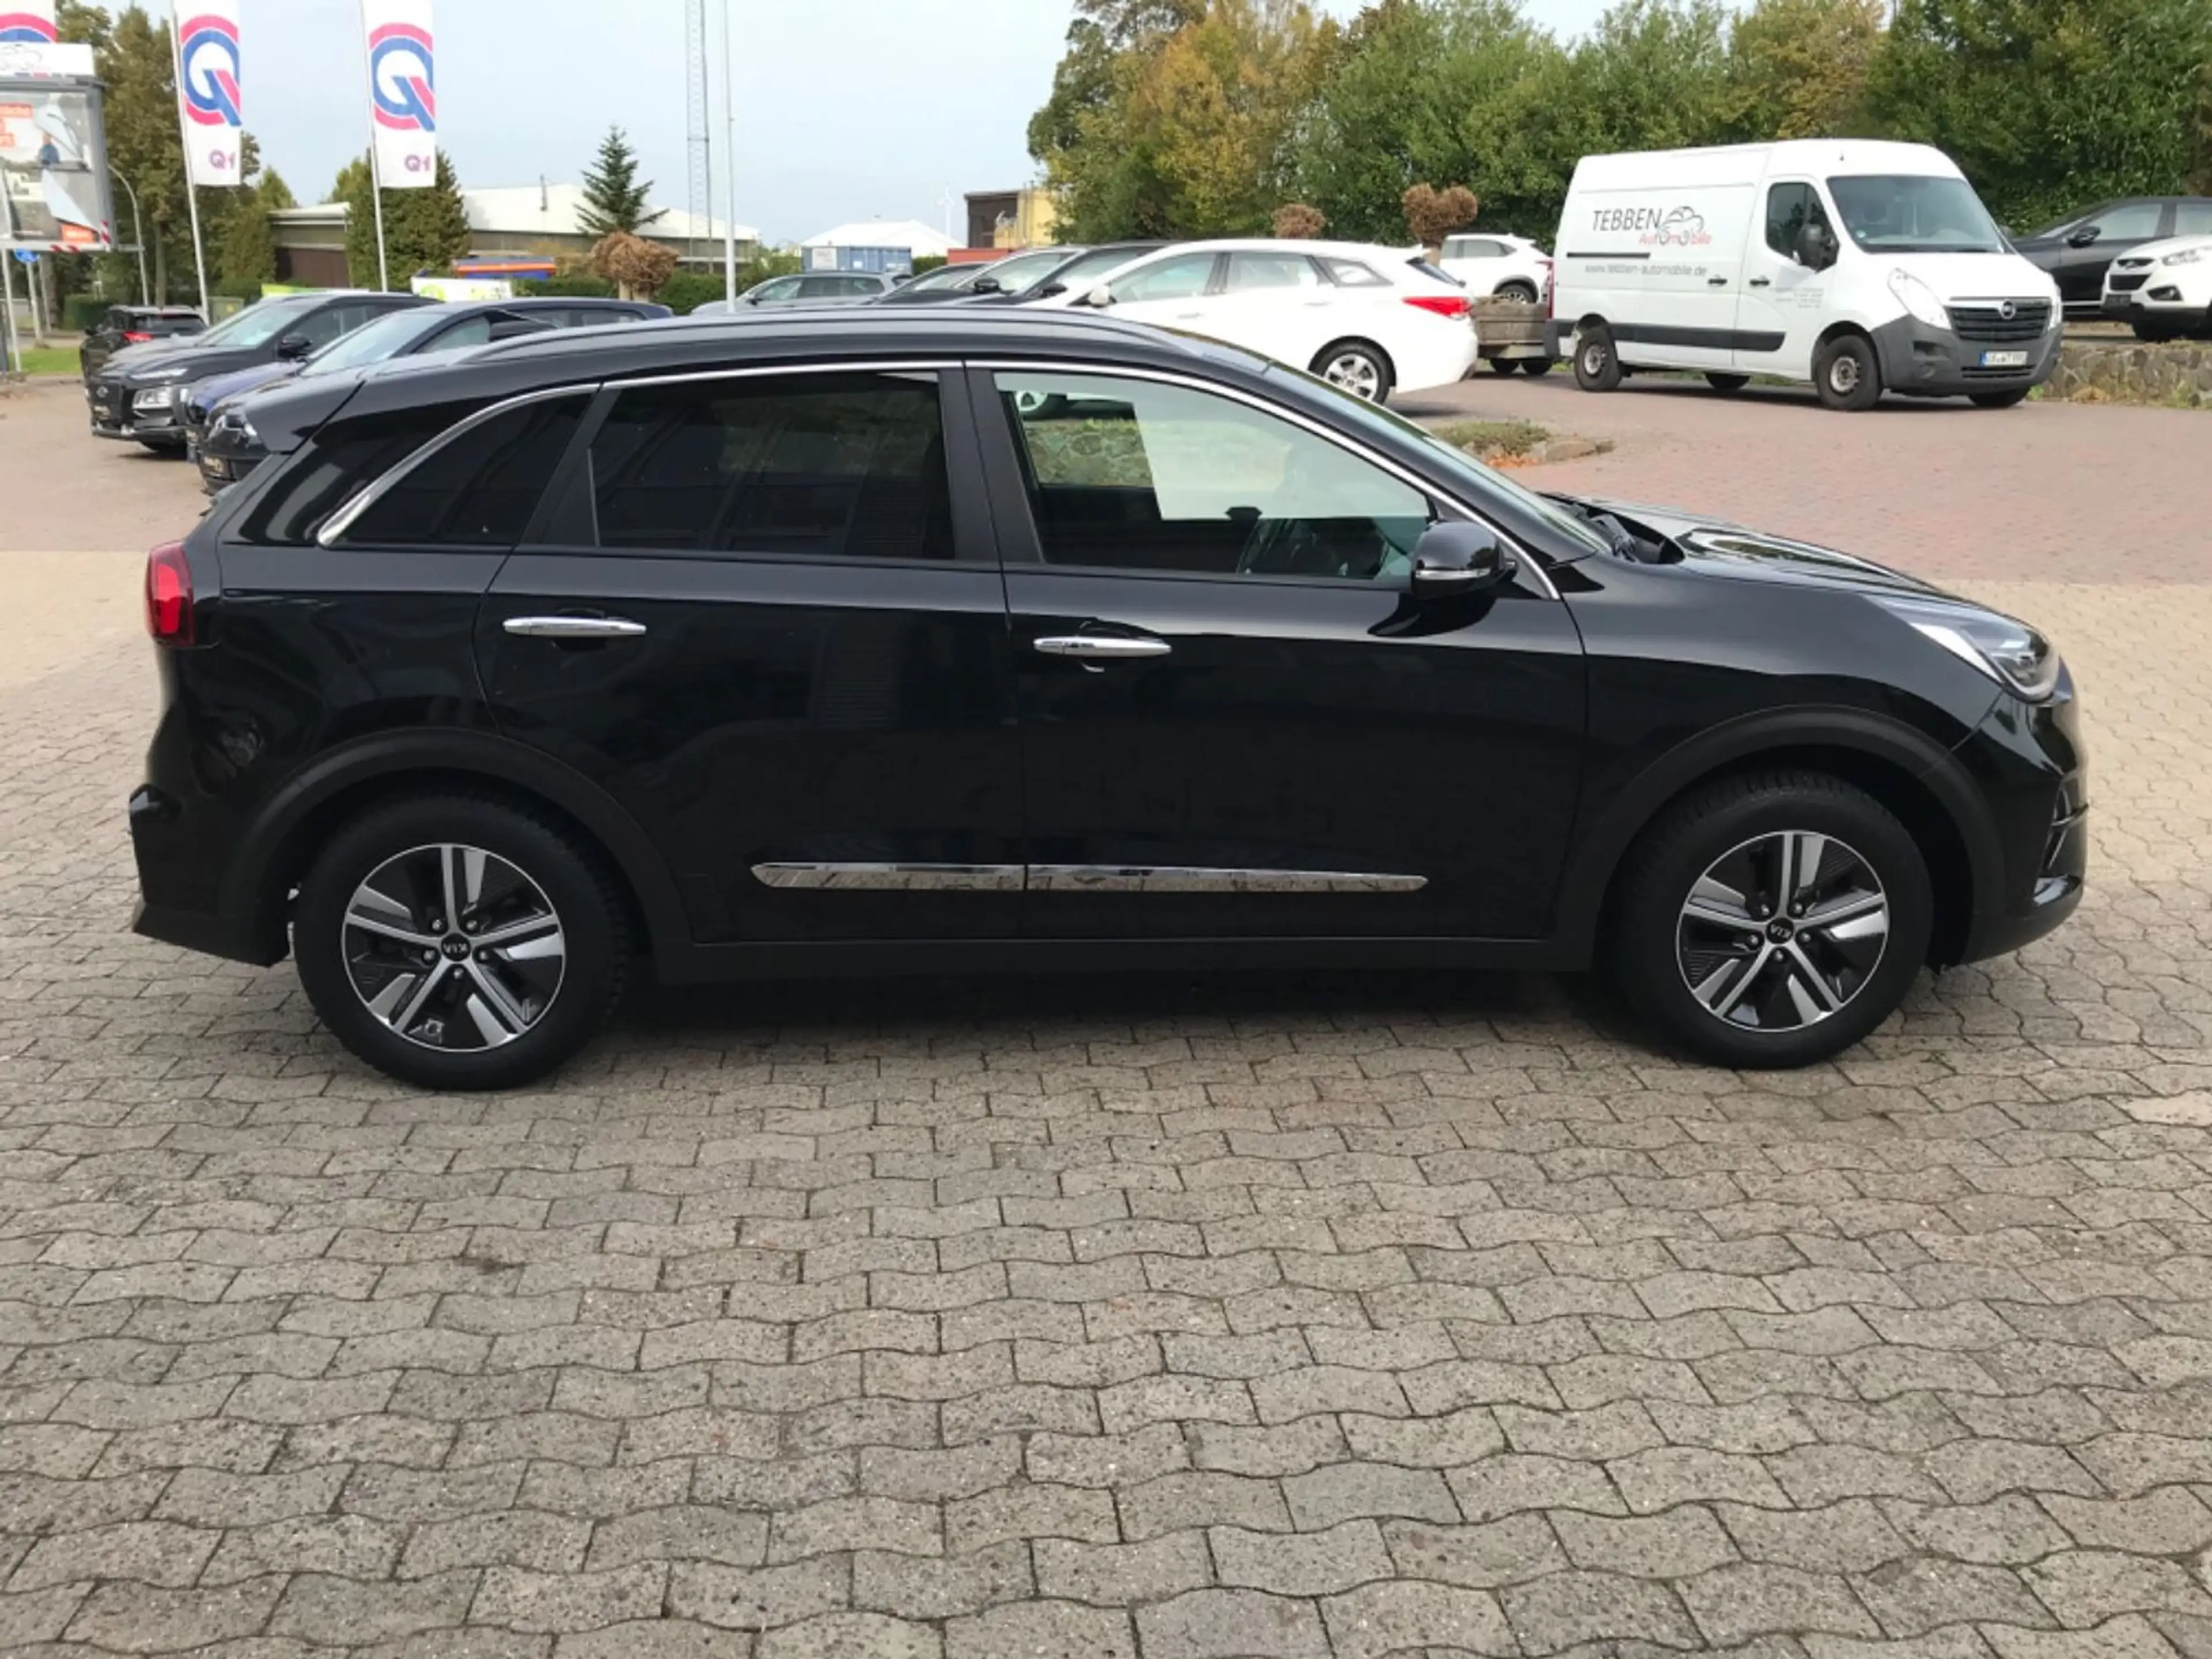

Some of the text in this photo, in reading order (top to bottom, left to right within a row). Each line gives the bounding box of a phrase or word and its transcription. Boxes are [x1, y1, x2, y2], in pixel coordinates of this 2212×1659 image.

[208, 149, 236, 170] Q1
[404, 153, 431, 172] Q1
[1592, 208, 1663, 232] TEBBEN
